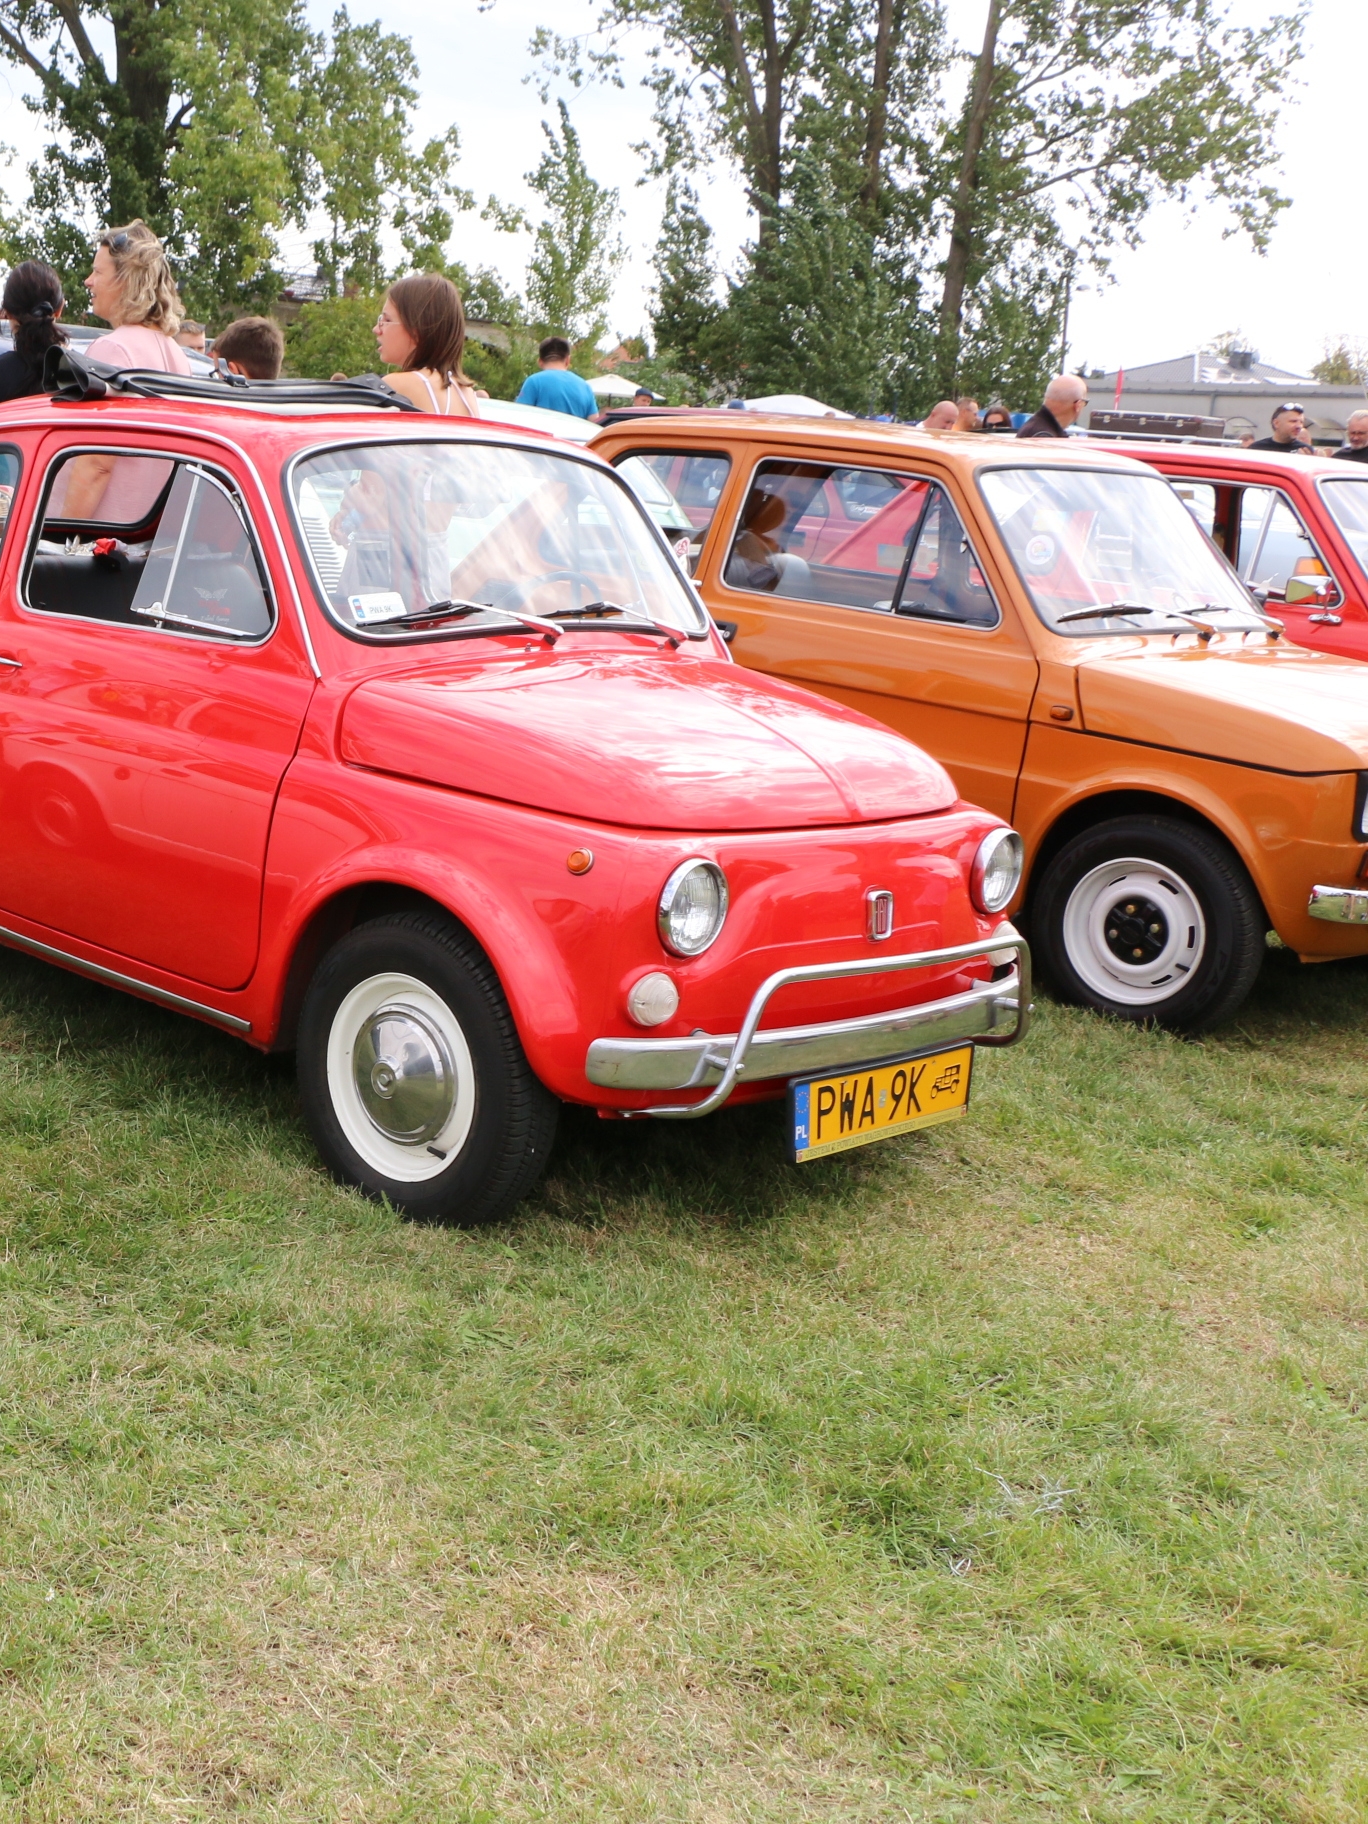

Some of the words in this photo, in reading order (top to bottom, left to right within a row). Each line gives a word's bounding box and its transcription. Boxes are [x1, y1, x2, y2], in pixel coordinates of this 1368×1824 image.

[817, 1076, 875, 1140] PWA
[888, 1063, 927, 1121] 9K
[795, 1125, 808, 1141] PL
